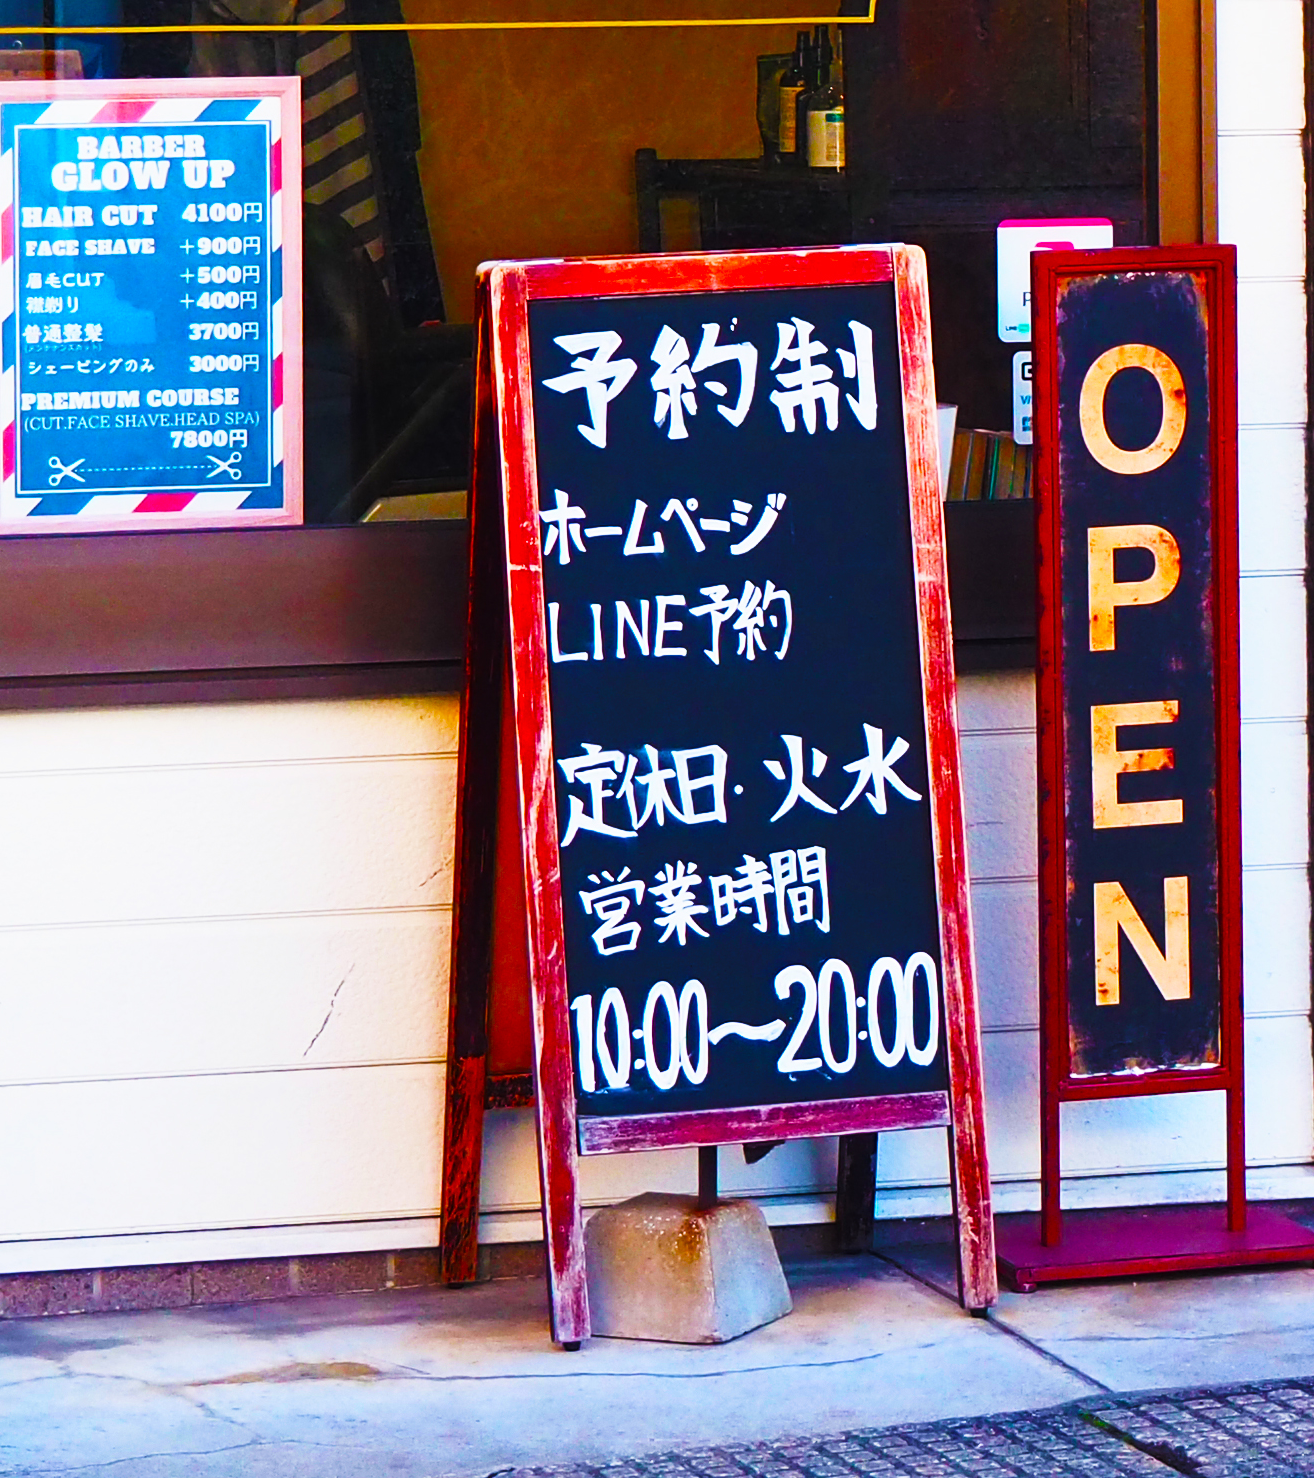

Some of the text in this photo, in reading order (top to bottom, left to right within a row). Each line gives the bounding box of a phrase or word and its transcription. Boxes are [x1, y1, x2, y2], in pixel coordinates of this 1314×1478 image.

[77, 134, 206, 160] BARBER
[51, 159, 236, 192] GLOW UP
[21, 202, 263, 228] HAIR CUT 4100円
[25, 236, 261, 256] FACE SHAVE +900円
[25, 265, 260, 289] 眉毛CUT +500円
[179, 291, 257, 310] +400円
[22, 322, 260, 343] 普通整髪 3700円
[28, 354, 260, 375] シェービングのみ 3000円
[541, 316, 879, 448] 予約制
[21, 388, 239, 411] PREMIUM COURSE
[224, 411, 260, 427] SPA)
[170, 429, 248, 449] 7800円
[536, 489, 787, 568] ホームページ
[548, 578, 795, 667] LINE予約
[1077, 342, 1192, 1007] OPEN
[578, 845, 832, 956] 営業時間
